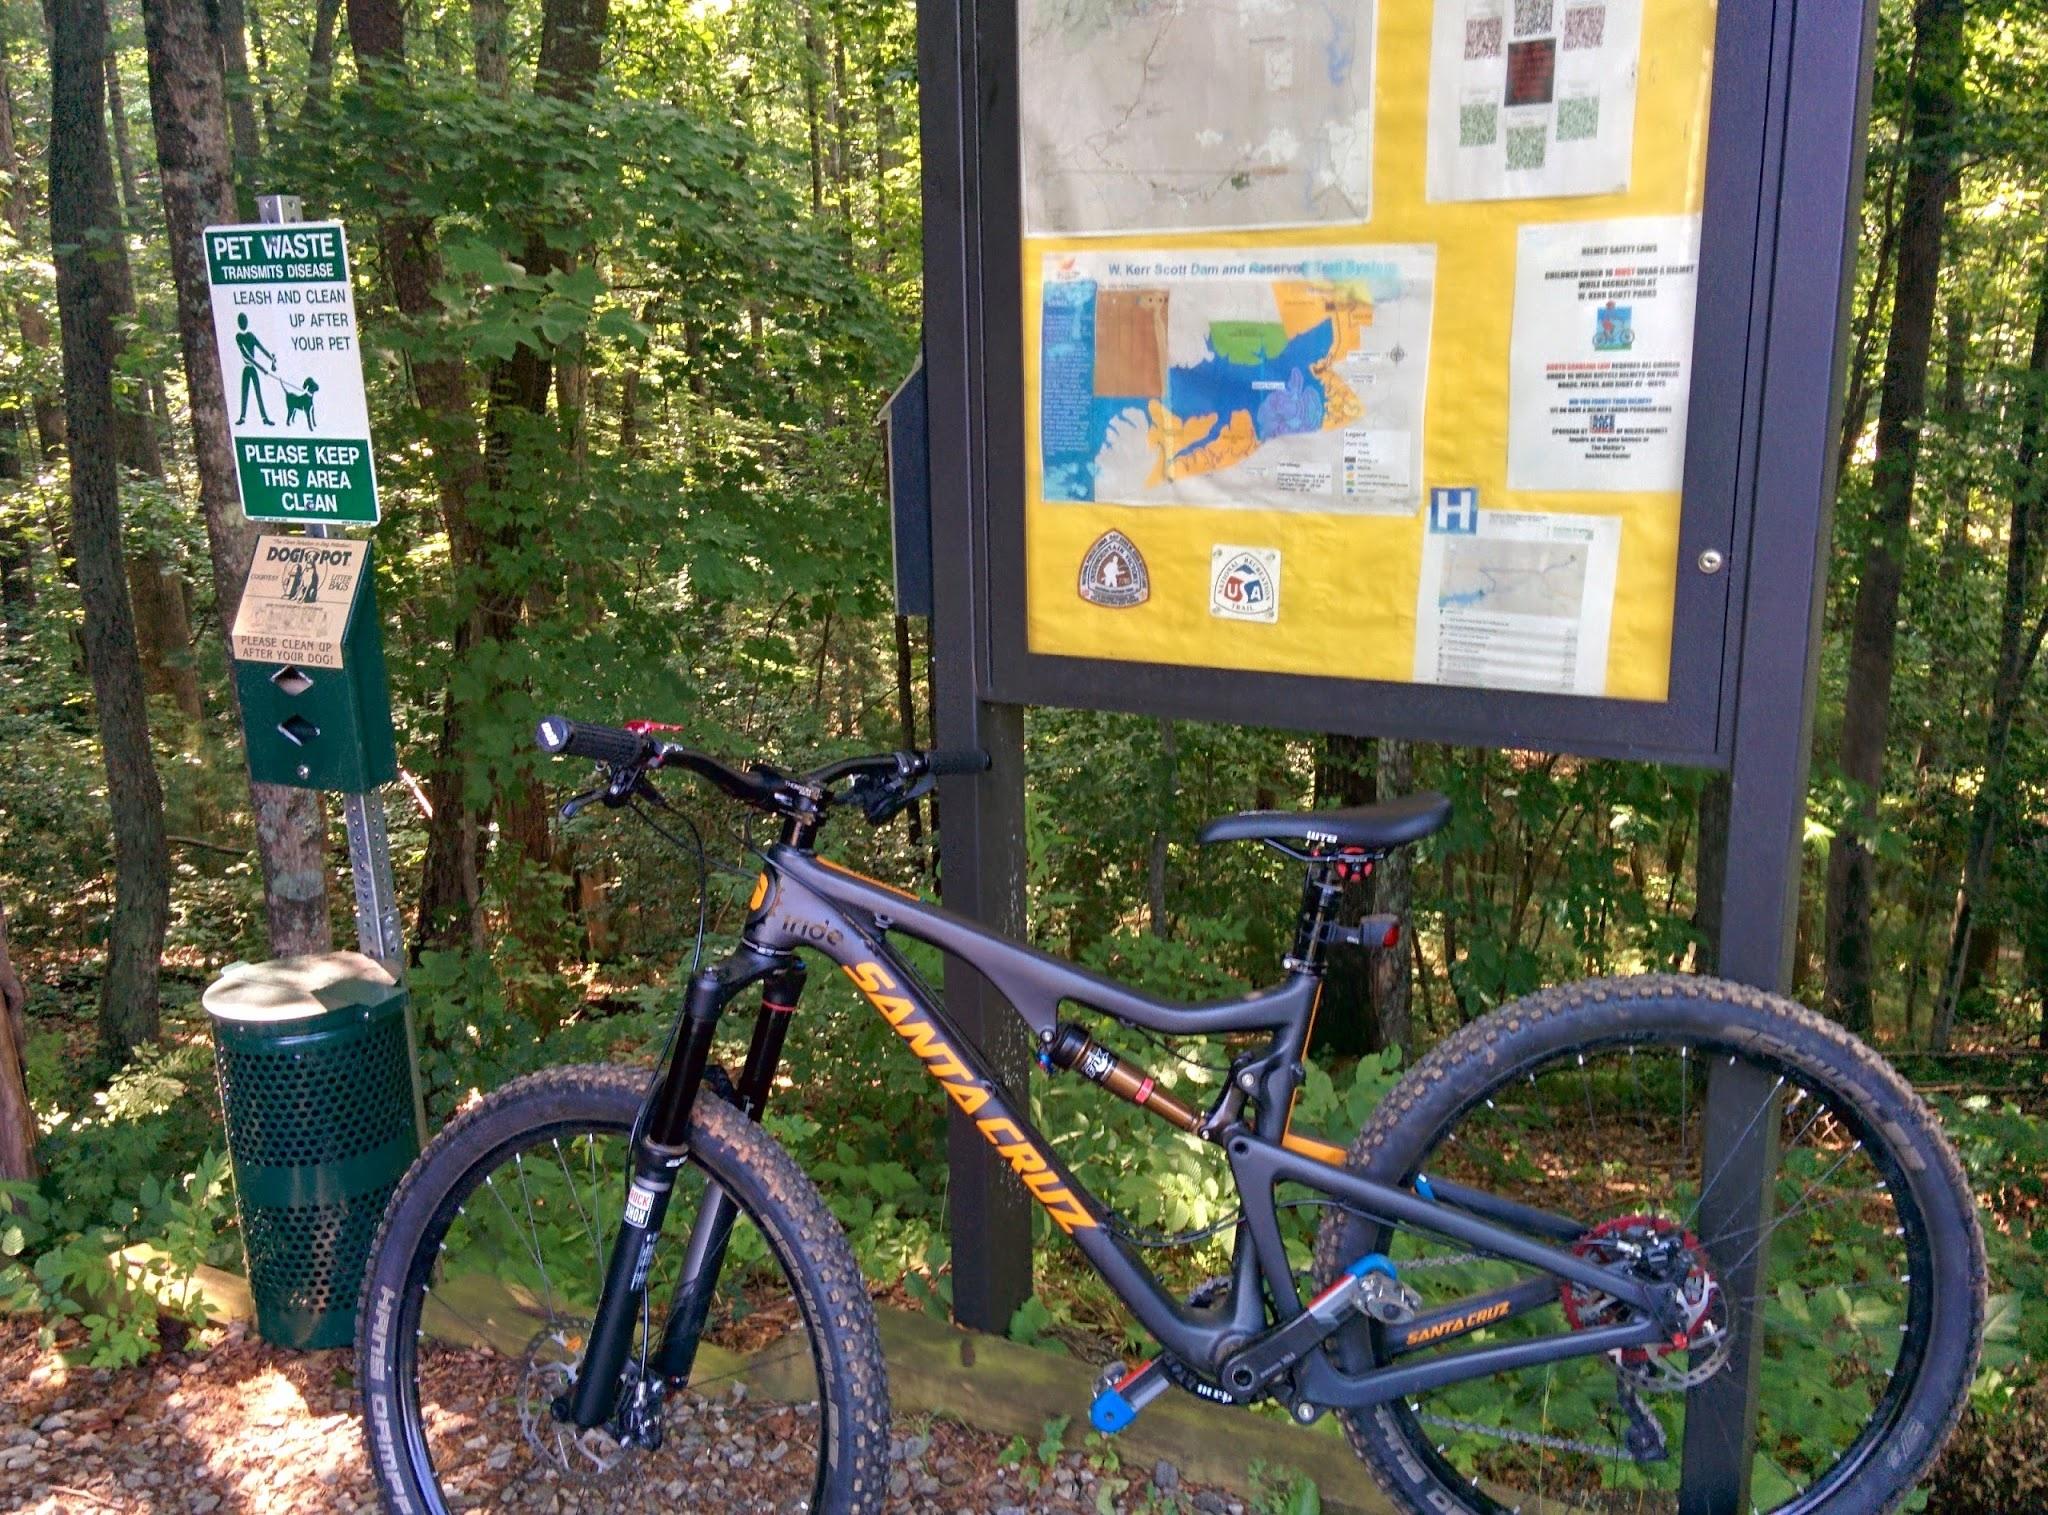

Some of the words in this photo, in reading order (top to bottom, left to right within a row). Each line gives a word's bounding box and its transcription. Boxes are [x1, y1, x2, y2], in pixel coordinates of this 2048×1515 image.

[214, 236, 253, 260] PET
[261, 233, 335, 259] WASTE
[222, 265, 283, 279] TRANSMITS
[288, 263, 334, 277] DISEASE
[1125, 263, 1150, 275] Kerr
[1155, 263, 1187, 275] Scott
[1190, 262, 1219, 275] Dam
[1222, 262, 1246, 275] and
[233, 291, 271, 305] LEASH
[277, 290, 301, 304] AND
[306, 289, 346, 304] CLEAN
[290, 314, 304, 327] UP
[310, 313, 348, 327] AFTER
[291, 337, 324, 350] YOUR
[329, 336, 351, 350] PET
[245, 445, 310, 464] PLEASE
[315, 446, 360, 465] KEEP
[260, 469, 300, 487] THIS
[306, 470, 352, 489] AREA
[281, 492, 338, 512] CLEAN
[1437, 490, 1472, 529] H
[331, 574, 352, 582] LITTER
[328, 582, 349, 592] BAGS
[241, 636, 277, 648] PLEASE
[282, 639, 314, 650] CLEAN
[318, 642, 332, 652] UP
[243, 648, 272, 659] AFTER
[276, 650, 304, 662] YOUR
[308, 654, 333, 665] DOG!
[1306, 830, 1338, 844] WTB
[841, 961, 991, 1116] SANTA
[975, 1116, 1099, 1235] CRUZ
[1407, 1317, 1464, 1346] SANTA
[1466, 1300, 1511, 1328] CRUZ
[369, 1284, 396, 1381] HANS
